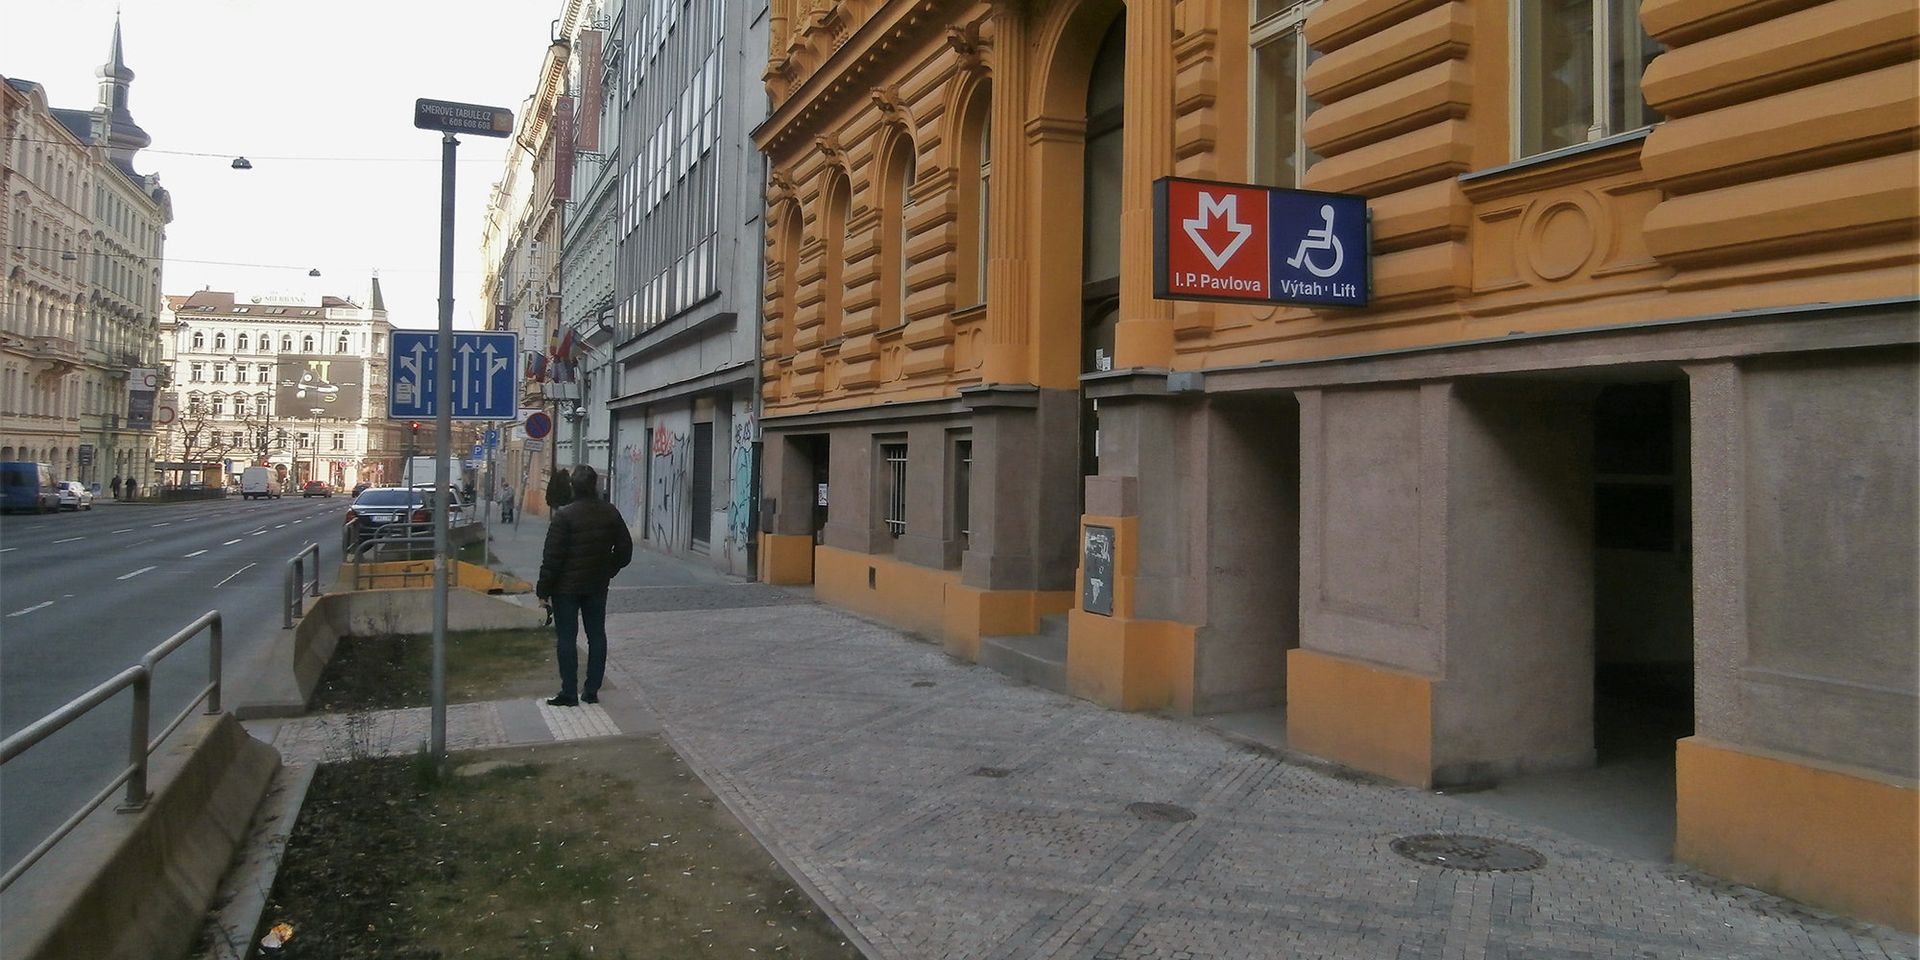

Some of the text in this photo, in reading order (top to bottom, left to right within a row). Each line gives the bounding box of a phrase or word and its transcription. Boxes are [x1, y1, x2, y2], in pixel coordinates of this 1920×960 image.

[1200, 274, 1261, 292] Pavlova
[1281, 279, 1356, 298] Výtah Lift
